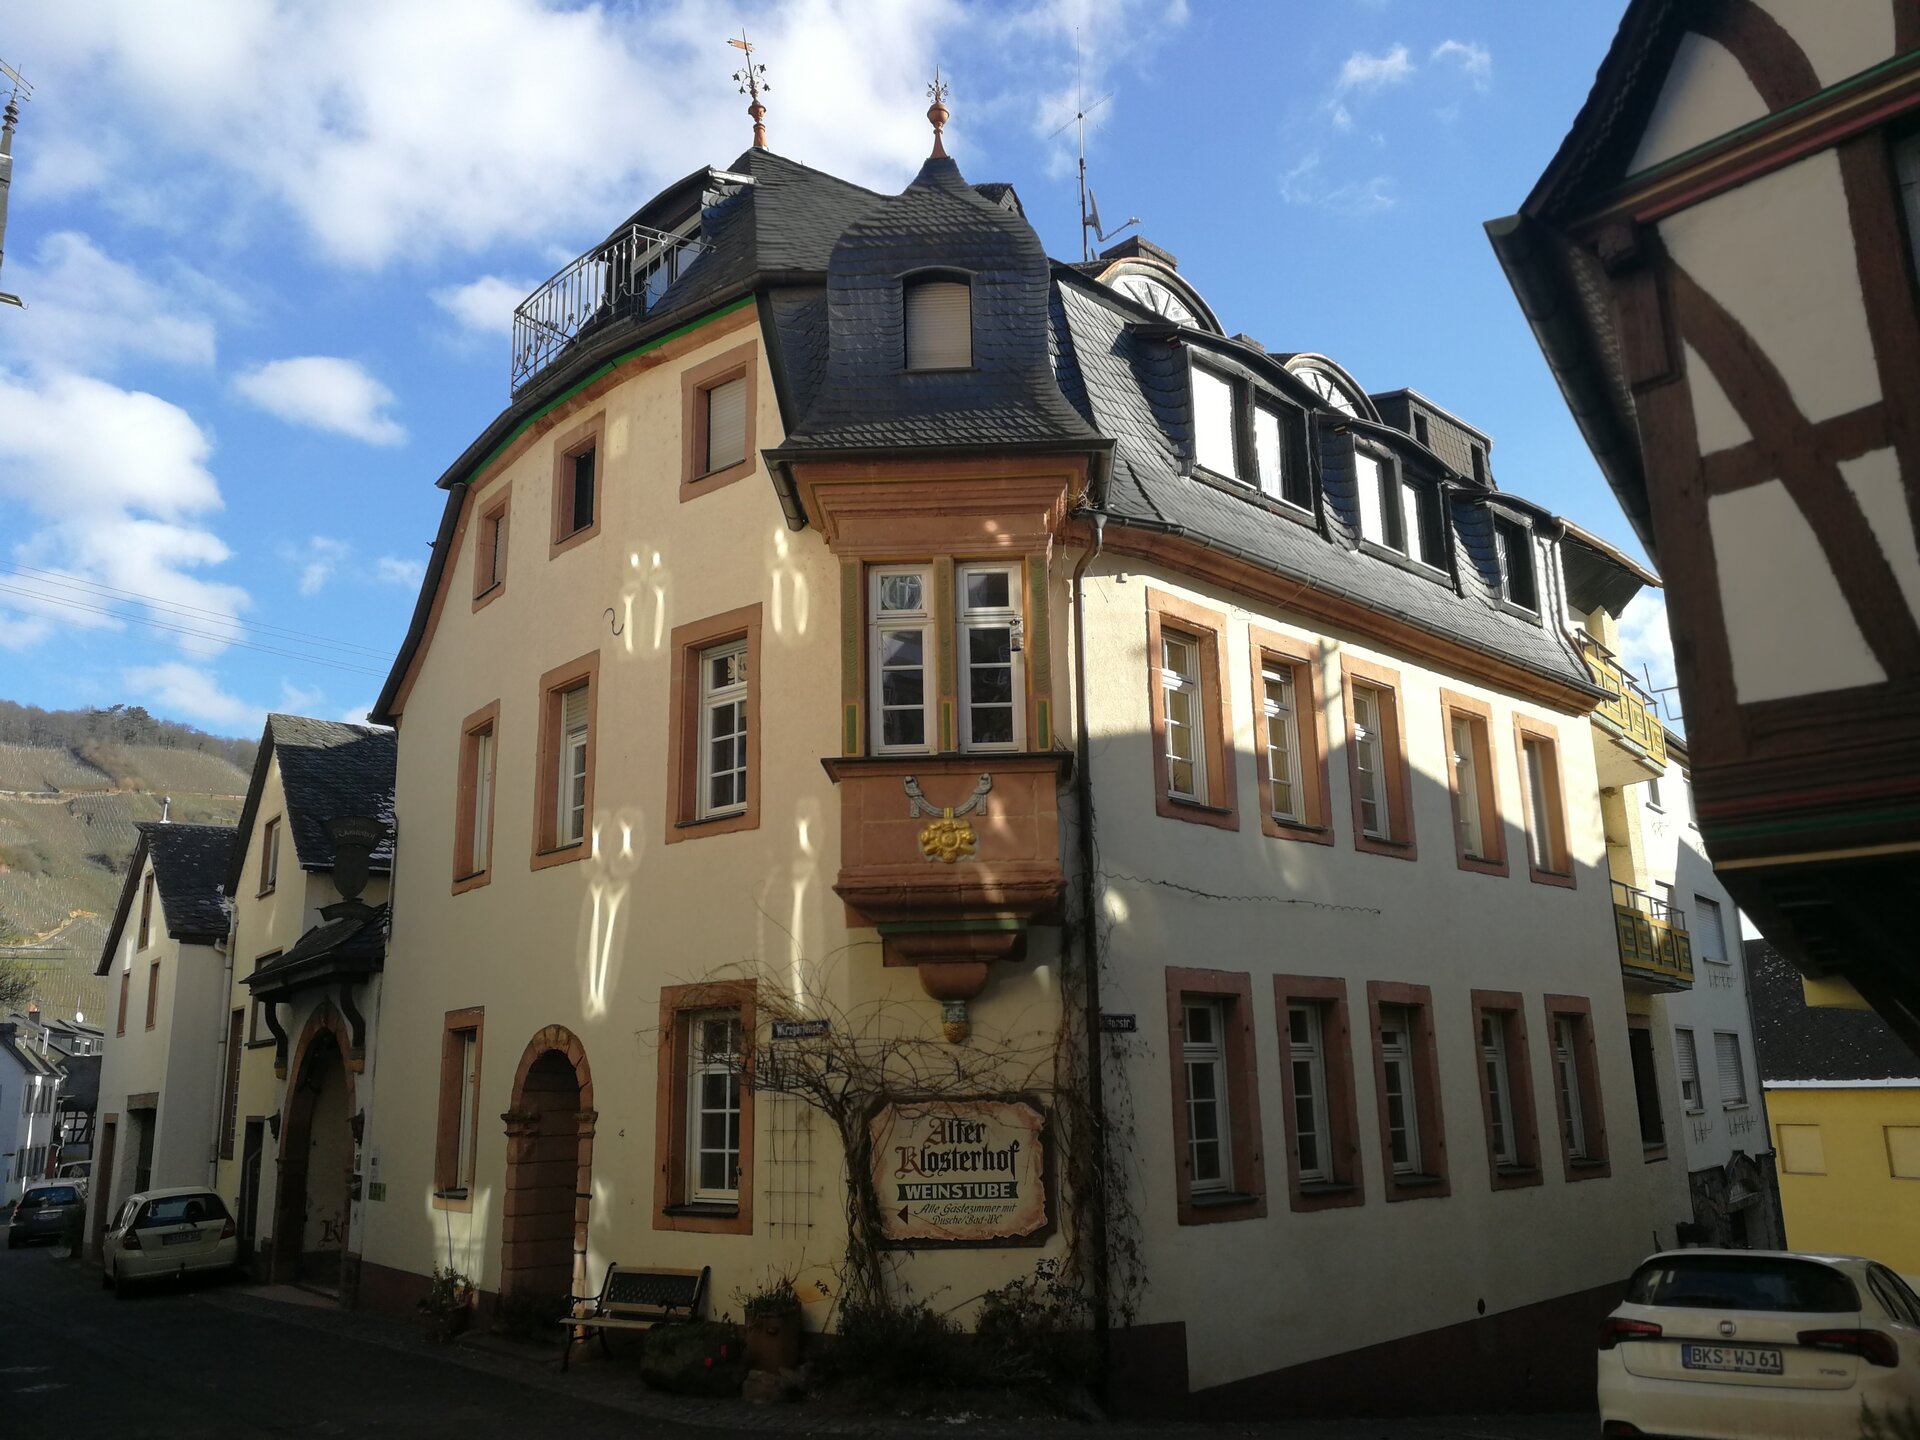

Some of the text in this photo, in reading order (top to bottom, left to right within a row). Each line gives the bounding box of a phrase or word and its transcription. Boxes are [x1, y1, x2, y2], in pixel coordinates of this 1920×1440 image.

[923, 1118, 987, 1147] Alter
[894, 1139, 1021, 1180] Klosterhof
[905, 1183, 1011, 1200] WEINSTUBE
[914, 1203, 940, 1215] Alle
[1002, 1203, 1017, 1213] mit
[1692, 1347, 1724, 1365] BKS
[1733, 1350, 1756, 1366] WJ
[1759, 1352, 1780, 1369] 61
